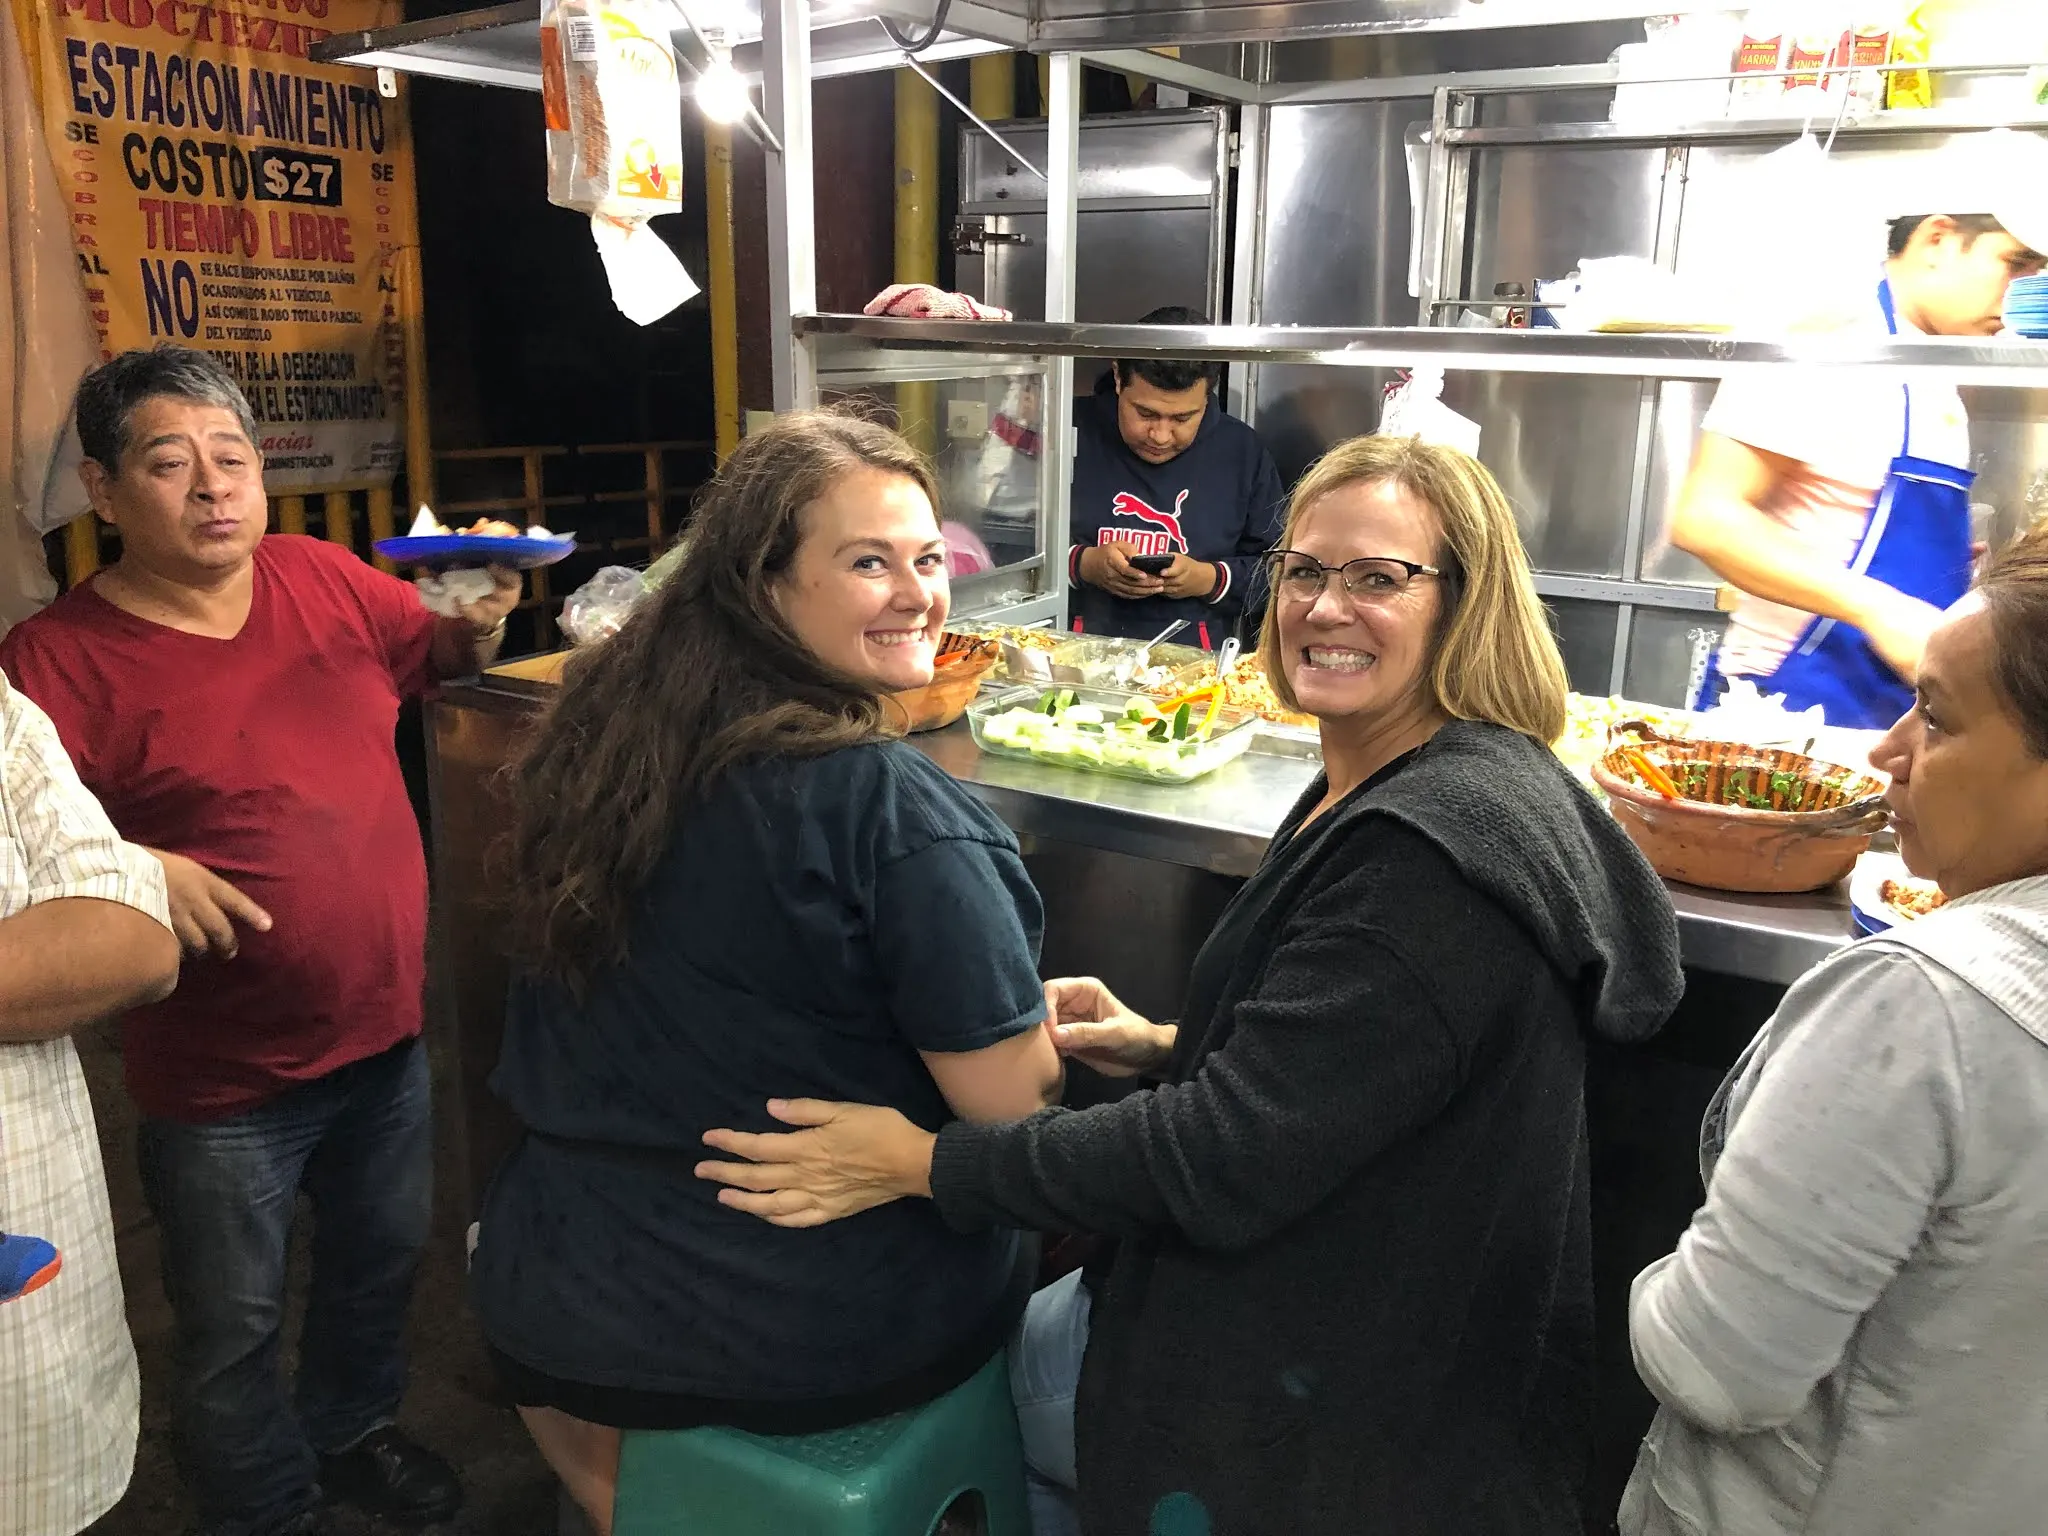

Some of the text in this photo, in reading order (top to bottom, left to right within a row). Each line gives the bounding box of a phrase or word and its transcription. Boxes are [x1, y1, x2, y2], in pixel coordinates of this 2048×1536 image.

[55, 0, 333, 58] MOCTEZU
[1740, 54, 1777, 67] HARINA
[66, 37, 386, 155] ESTACIONAMIENTO
[64, 120, 100, 145] SE
[122, 131, 334, 201] COSTO $27
[371, 162, 394, 182] SE
[139, 198, 355, 263] TIEMPO LIBRE
[200, 262, 213, 276] SE
[214, 262, 240, 278] HACE
[308, 268, 326, 283] POR
[140, 257, 199, 339] NO
[270, 288, 284, 302] AL
[250, 307, 260, 320] EL
[261, 308, 290, 321] ROBO
[291, 308, 320, 323] TOTAL
[321, 310, 328, 322] O
[329, 310, 363, 324] PARCIAL
[205, 326, 225, 340] DEL
[246, 351, 261, 381] DE
[262, 351, 280, 381] LA
[265, 386, 284, 422] EL
[260, 430, 313, 451] acias
[263, 453, 334, 471] DMINISTRACIÓN
[1098, 527, 1170, 556] PUMA
